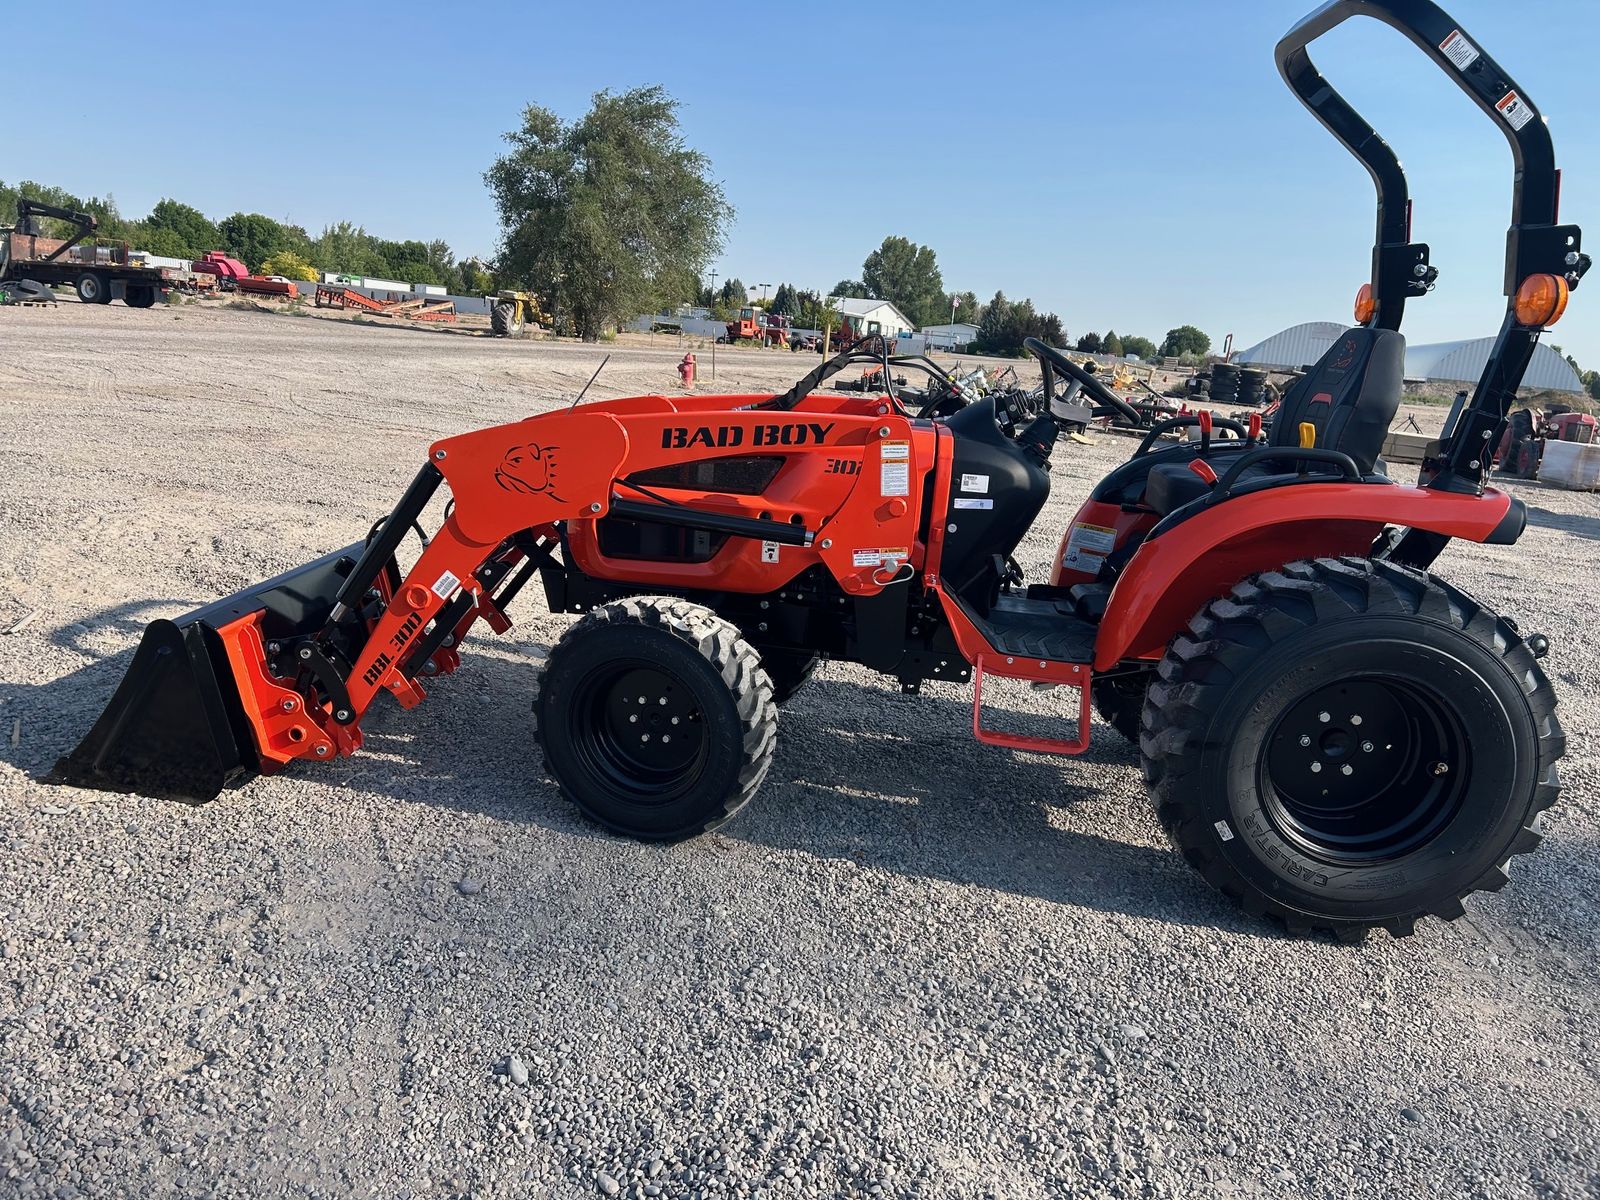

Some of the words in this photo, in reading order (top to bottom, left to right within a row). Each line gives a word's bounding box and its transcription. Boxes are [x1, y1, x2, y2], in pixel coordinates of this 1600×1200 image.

[662, 427, 744, 449] BAD
[753, 423, 836, 446] BOY
[362, 652, 395, 687] BBL
[388, 611, 423, 653] 300
[1243, 812, 1329, 887] CARLSTAR
